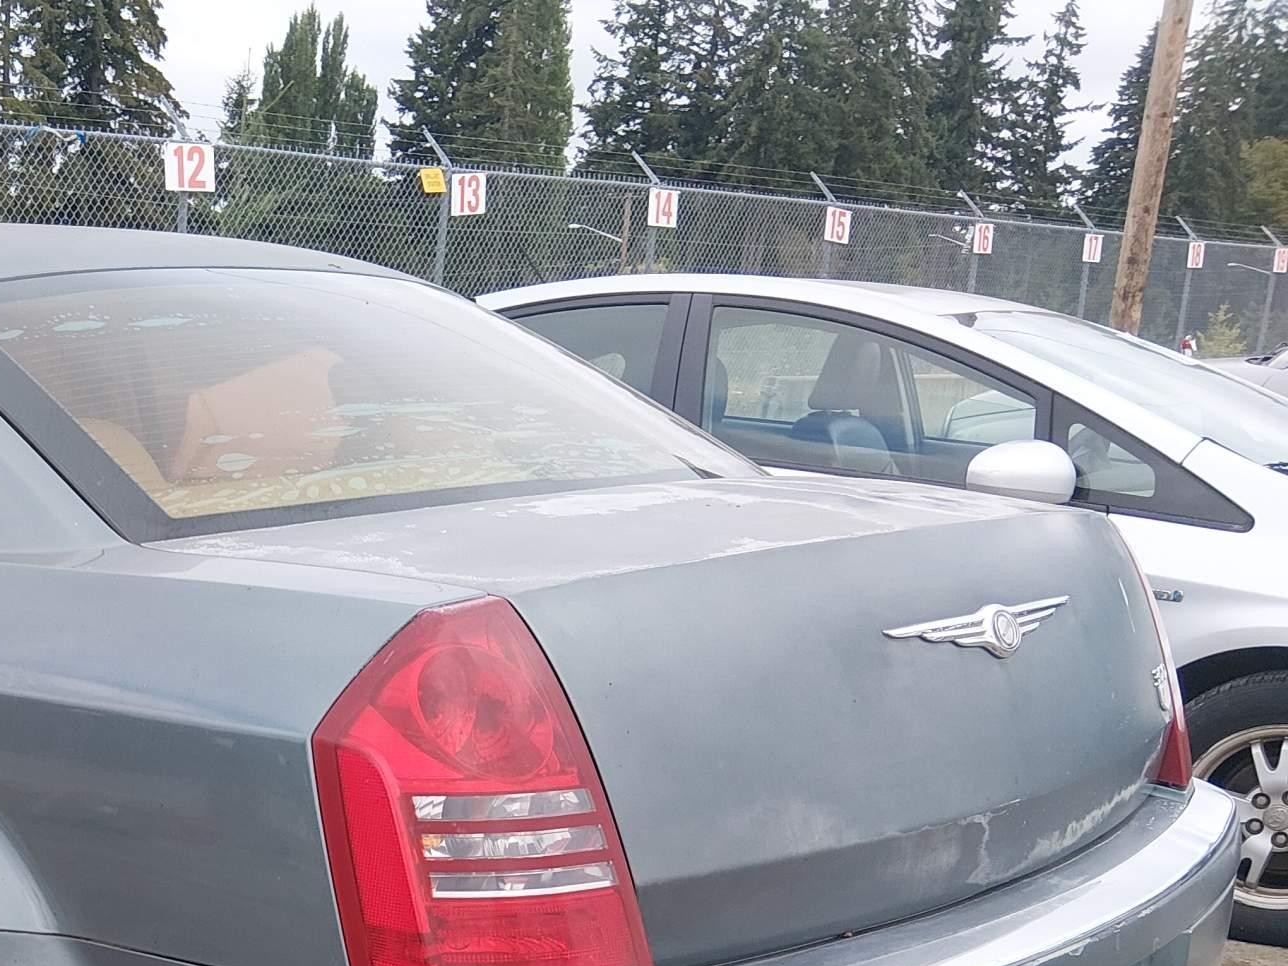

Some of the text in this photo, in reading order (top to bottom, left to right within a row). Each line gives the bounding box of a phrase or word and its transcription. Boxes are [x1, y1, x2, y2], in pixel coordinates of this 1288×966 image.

[173, 145, 206, 188] 12
[458, 175, 481, 213] 13
[655, 191, 673, 225] 14
[830, 209, 847, 241] 15
[978, 225, 990, 252] 16
[1088, 235, 1099, 261] 17
[1190, 243, 1202, 267] 18
